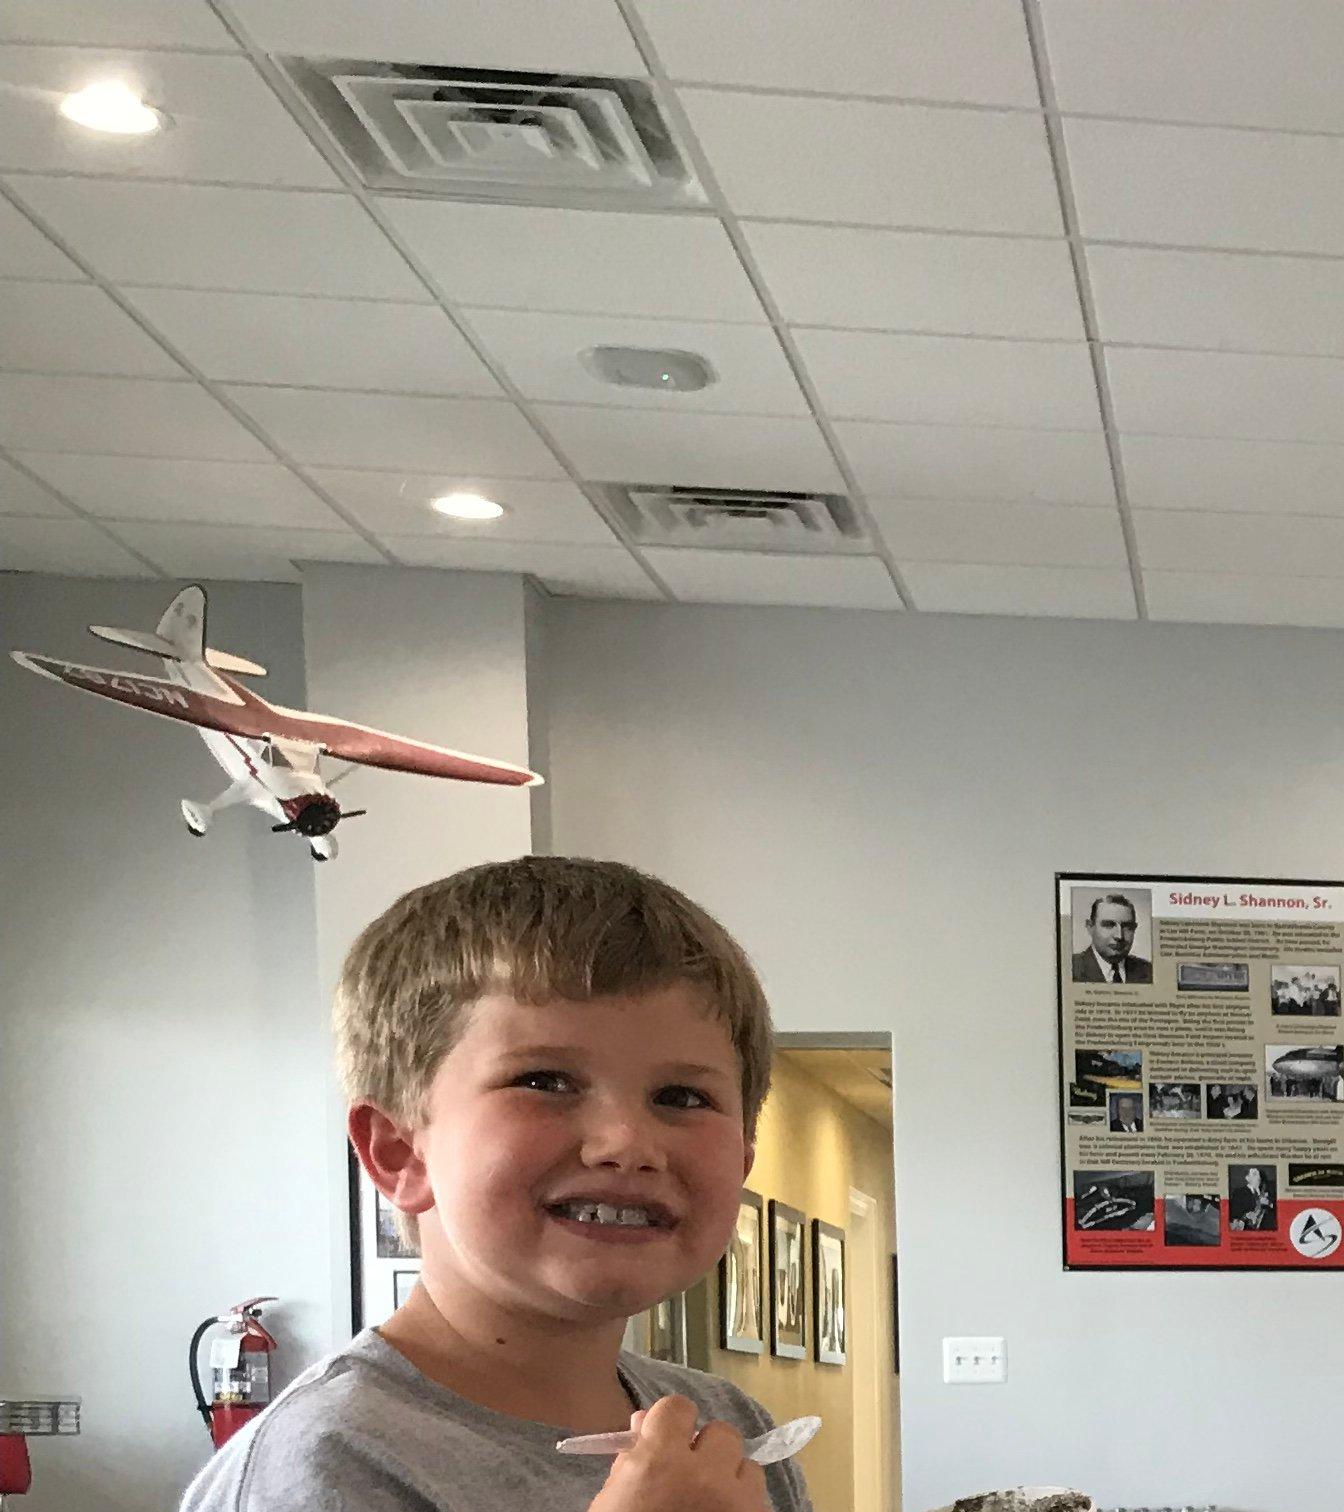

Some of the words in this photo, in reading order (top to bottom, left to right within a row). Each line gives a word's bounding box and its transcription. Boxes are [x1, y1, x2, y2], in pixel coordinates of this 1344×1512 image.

[1169, 892, 1220, 908] Sidney
[1224, 894, 1236, 906] L.
[1239, 894, 1309, 909] Shannon,
[1313, 896, 1332, 909] Sr.
